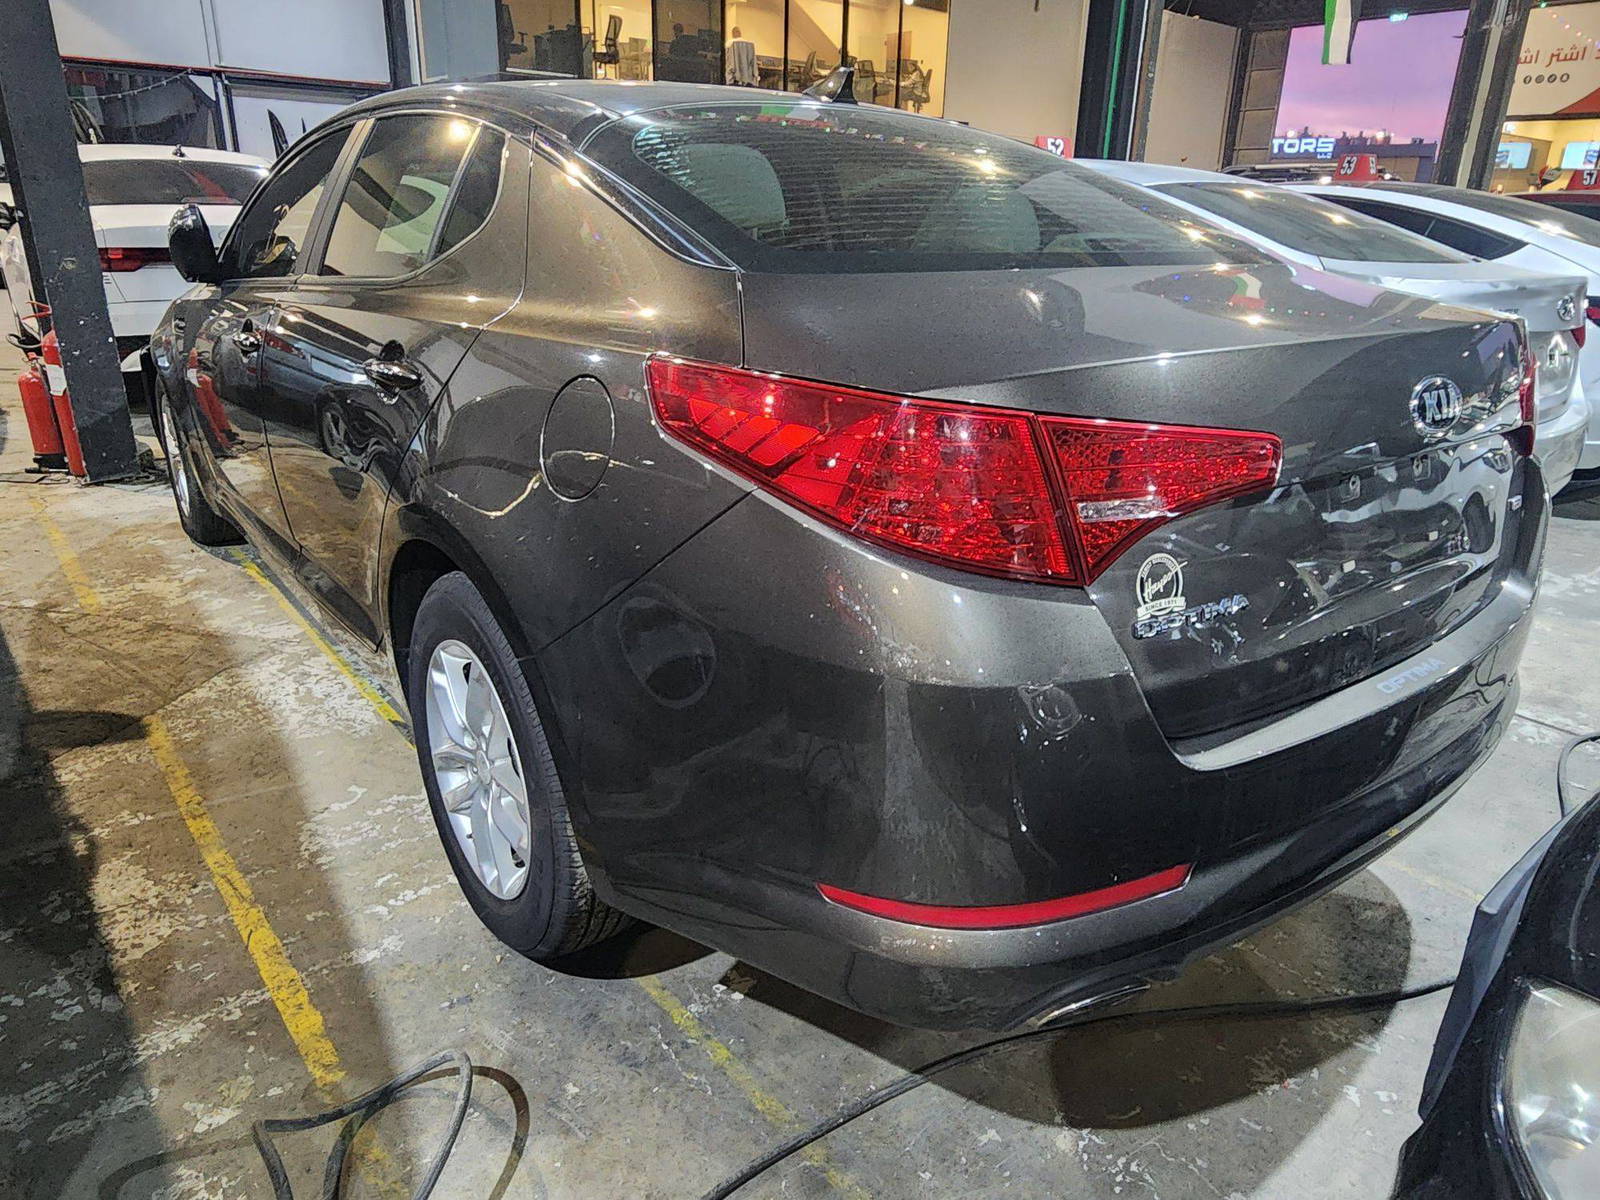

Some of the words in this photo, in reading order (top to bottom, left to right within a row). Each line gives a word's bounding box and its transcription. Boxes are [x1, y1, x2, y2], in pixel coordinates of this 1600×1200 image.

[1047, 137, 1065, 157] 52
[1272, 137, 1336, 154] TORS
[1340, 156, 1357, 175] 53
[1583, 170, 1597, 186] 57
[1144, 601, 1163, 611] SINCE
